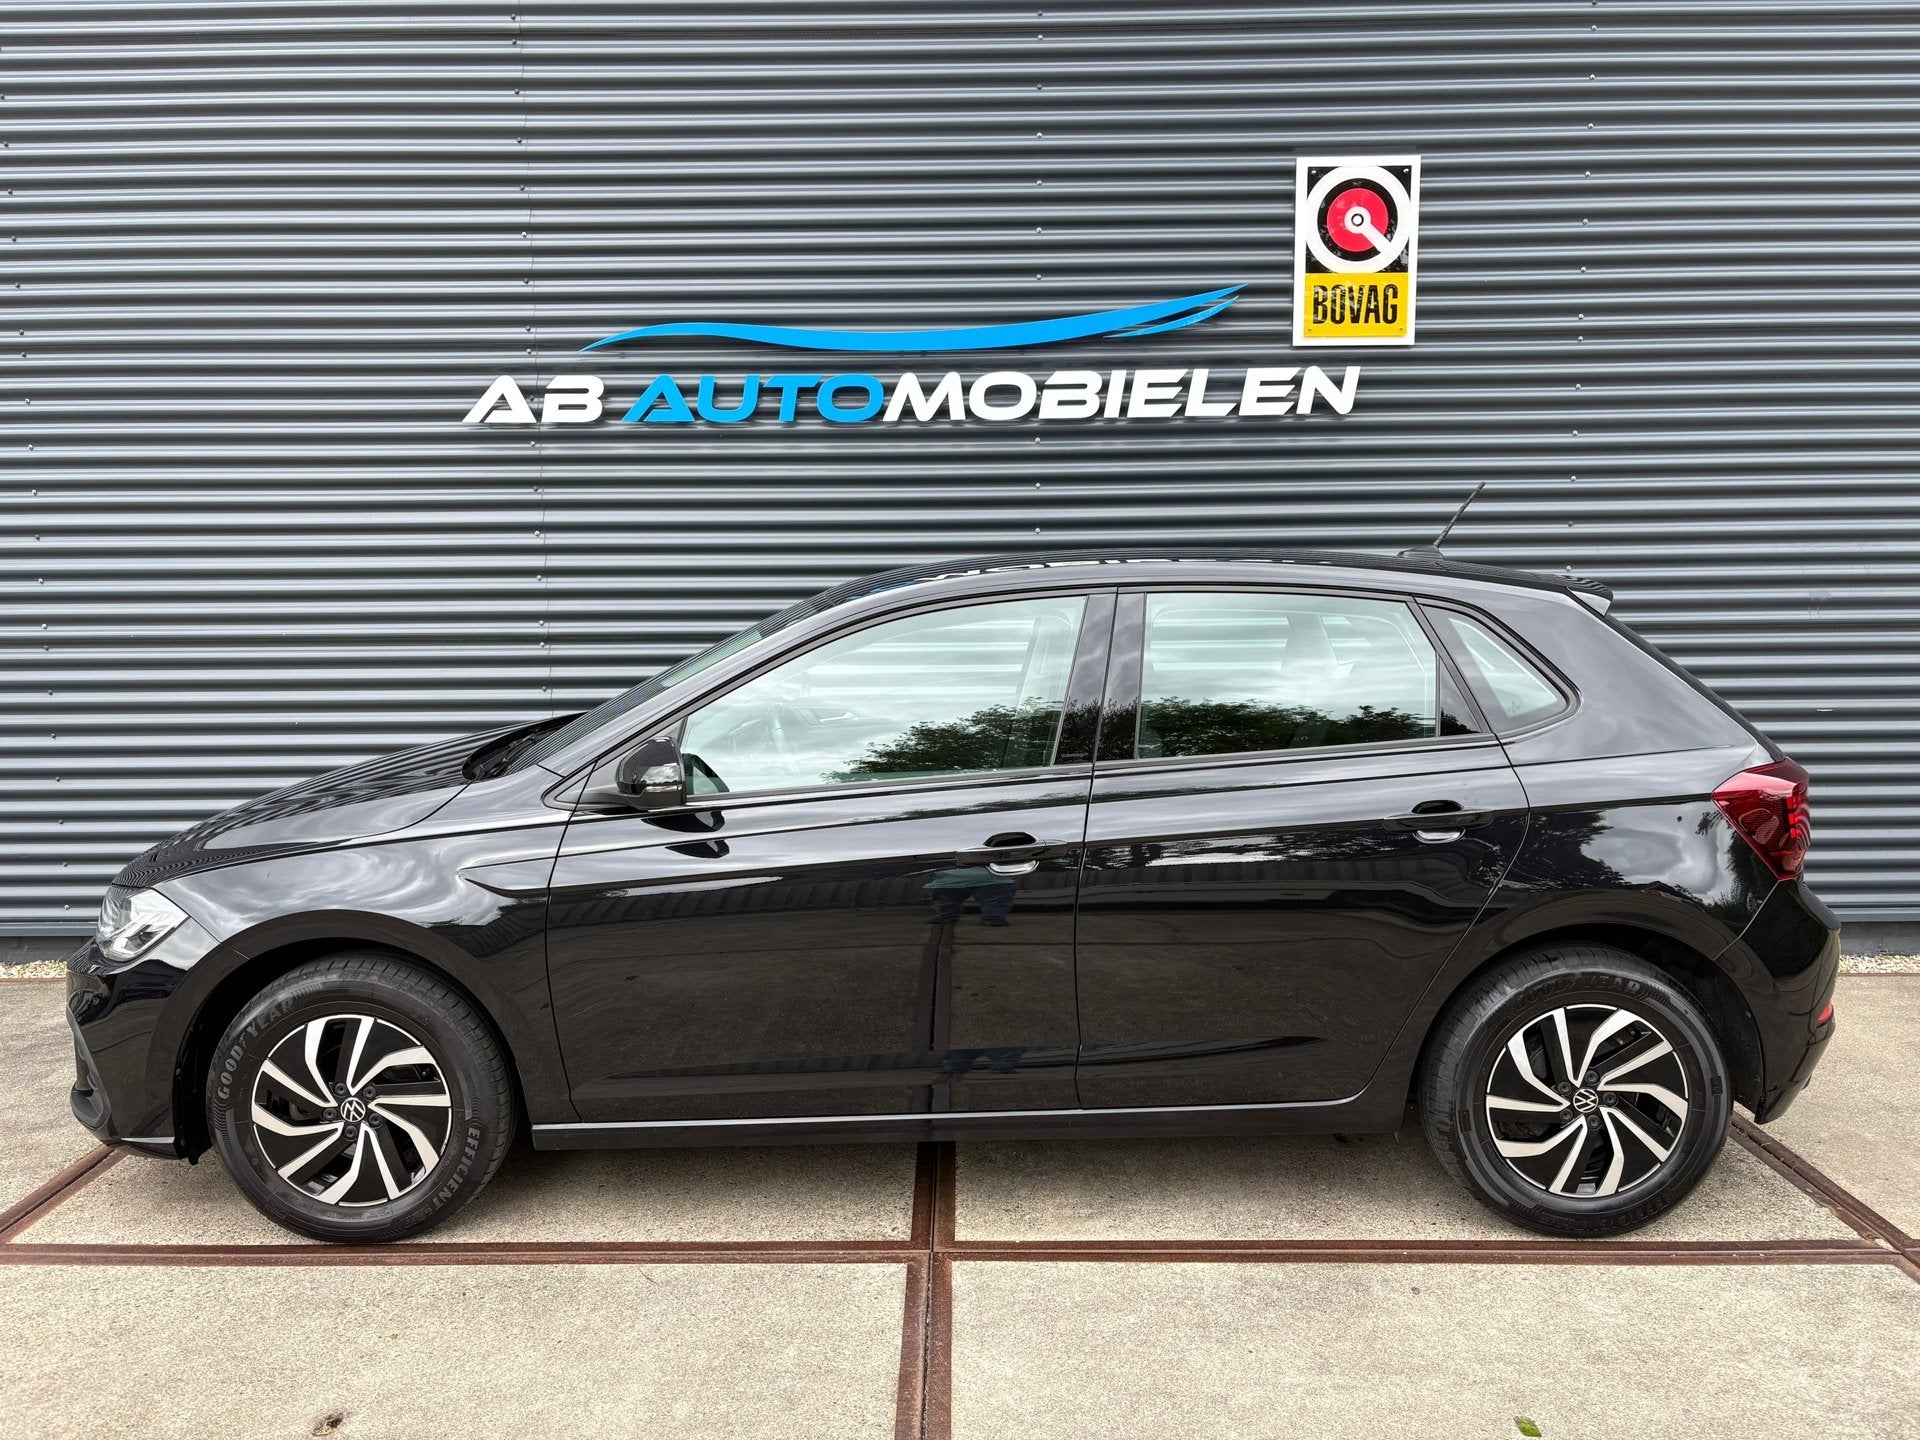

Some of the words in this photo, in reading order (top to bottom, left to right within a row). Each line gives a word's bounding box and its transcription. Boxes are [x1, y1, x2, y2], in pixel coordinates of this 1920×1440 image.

[1312, 284, 1399, 325] BOVAG
[462, 375, 604, 423] AB
[621, 366, 1361, 423] AUTOMOBIELEN
[432, 1127, 480, 1209] EFFICIENT
